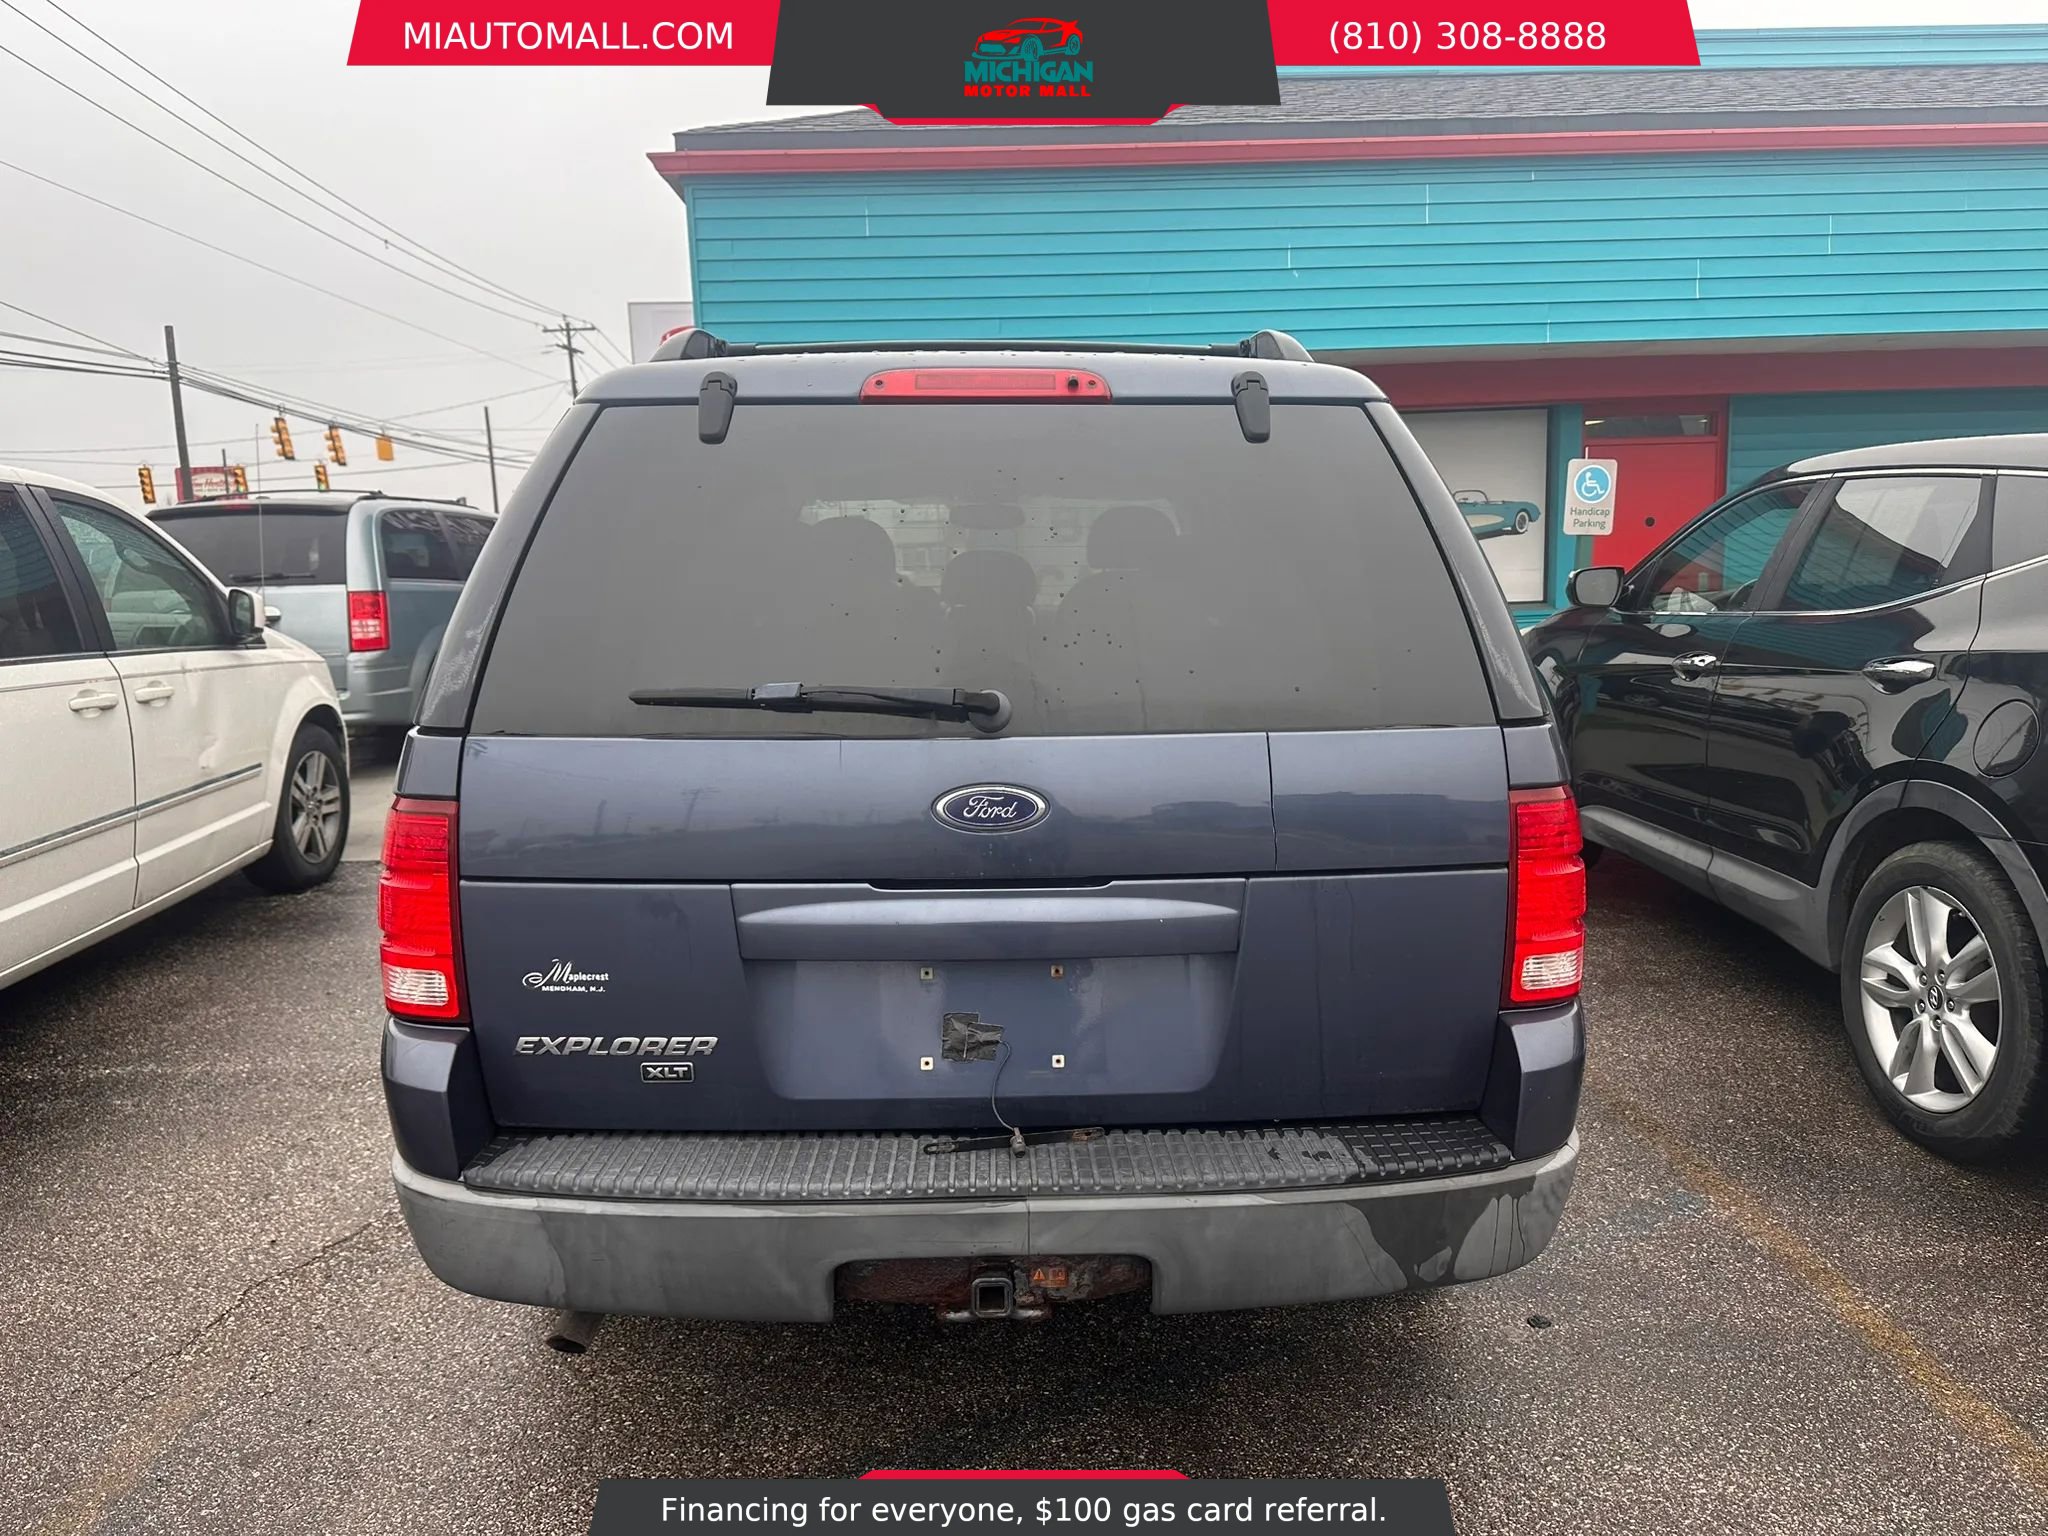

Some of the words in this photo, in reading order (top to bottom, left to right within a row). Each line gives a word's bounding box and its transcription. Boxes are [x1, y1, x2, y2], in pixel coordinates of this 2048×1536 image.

[1570, 507, 1610, 518] Handicap
[1573, 518, 1606, 530] Parking
[963, 795, 1018, 818] Ford
[522, 958, 610, 989] Maplecrest
[515, 1036, 719, 1056] EXPLORER
[647, 1066, 688, 1079] XLT
